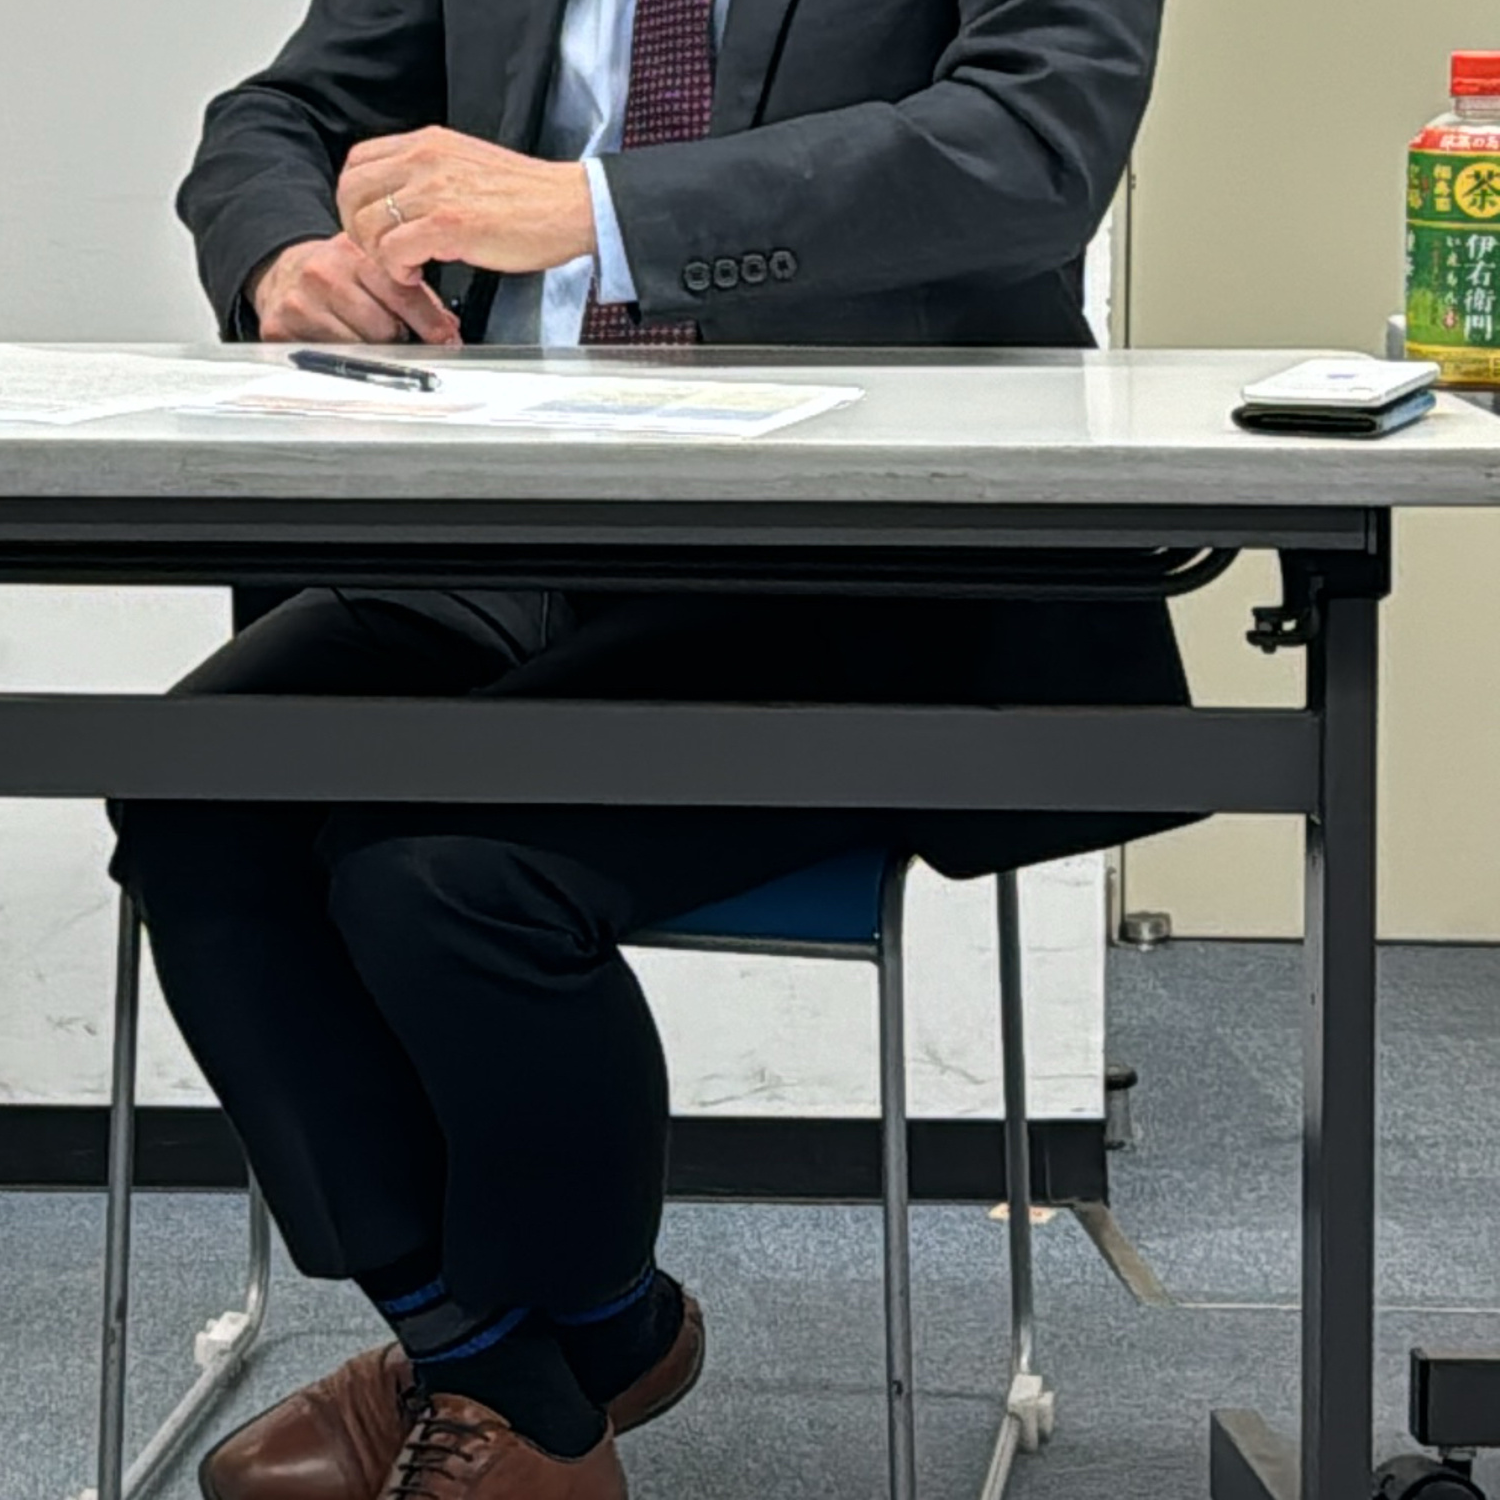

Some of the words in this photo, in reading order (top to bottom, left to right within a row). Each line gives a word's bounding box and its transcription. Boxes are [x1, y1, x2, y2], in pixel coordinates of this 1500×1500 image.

[1461, 169, 1500, 213] 茶
[1464, 233, 1500, 342] 伊右衛門
